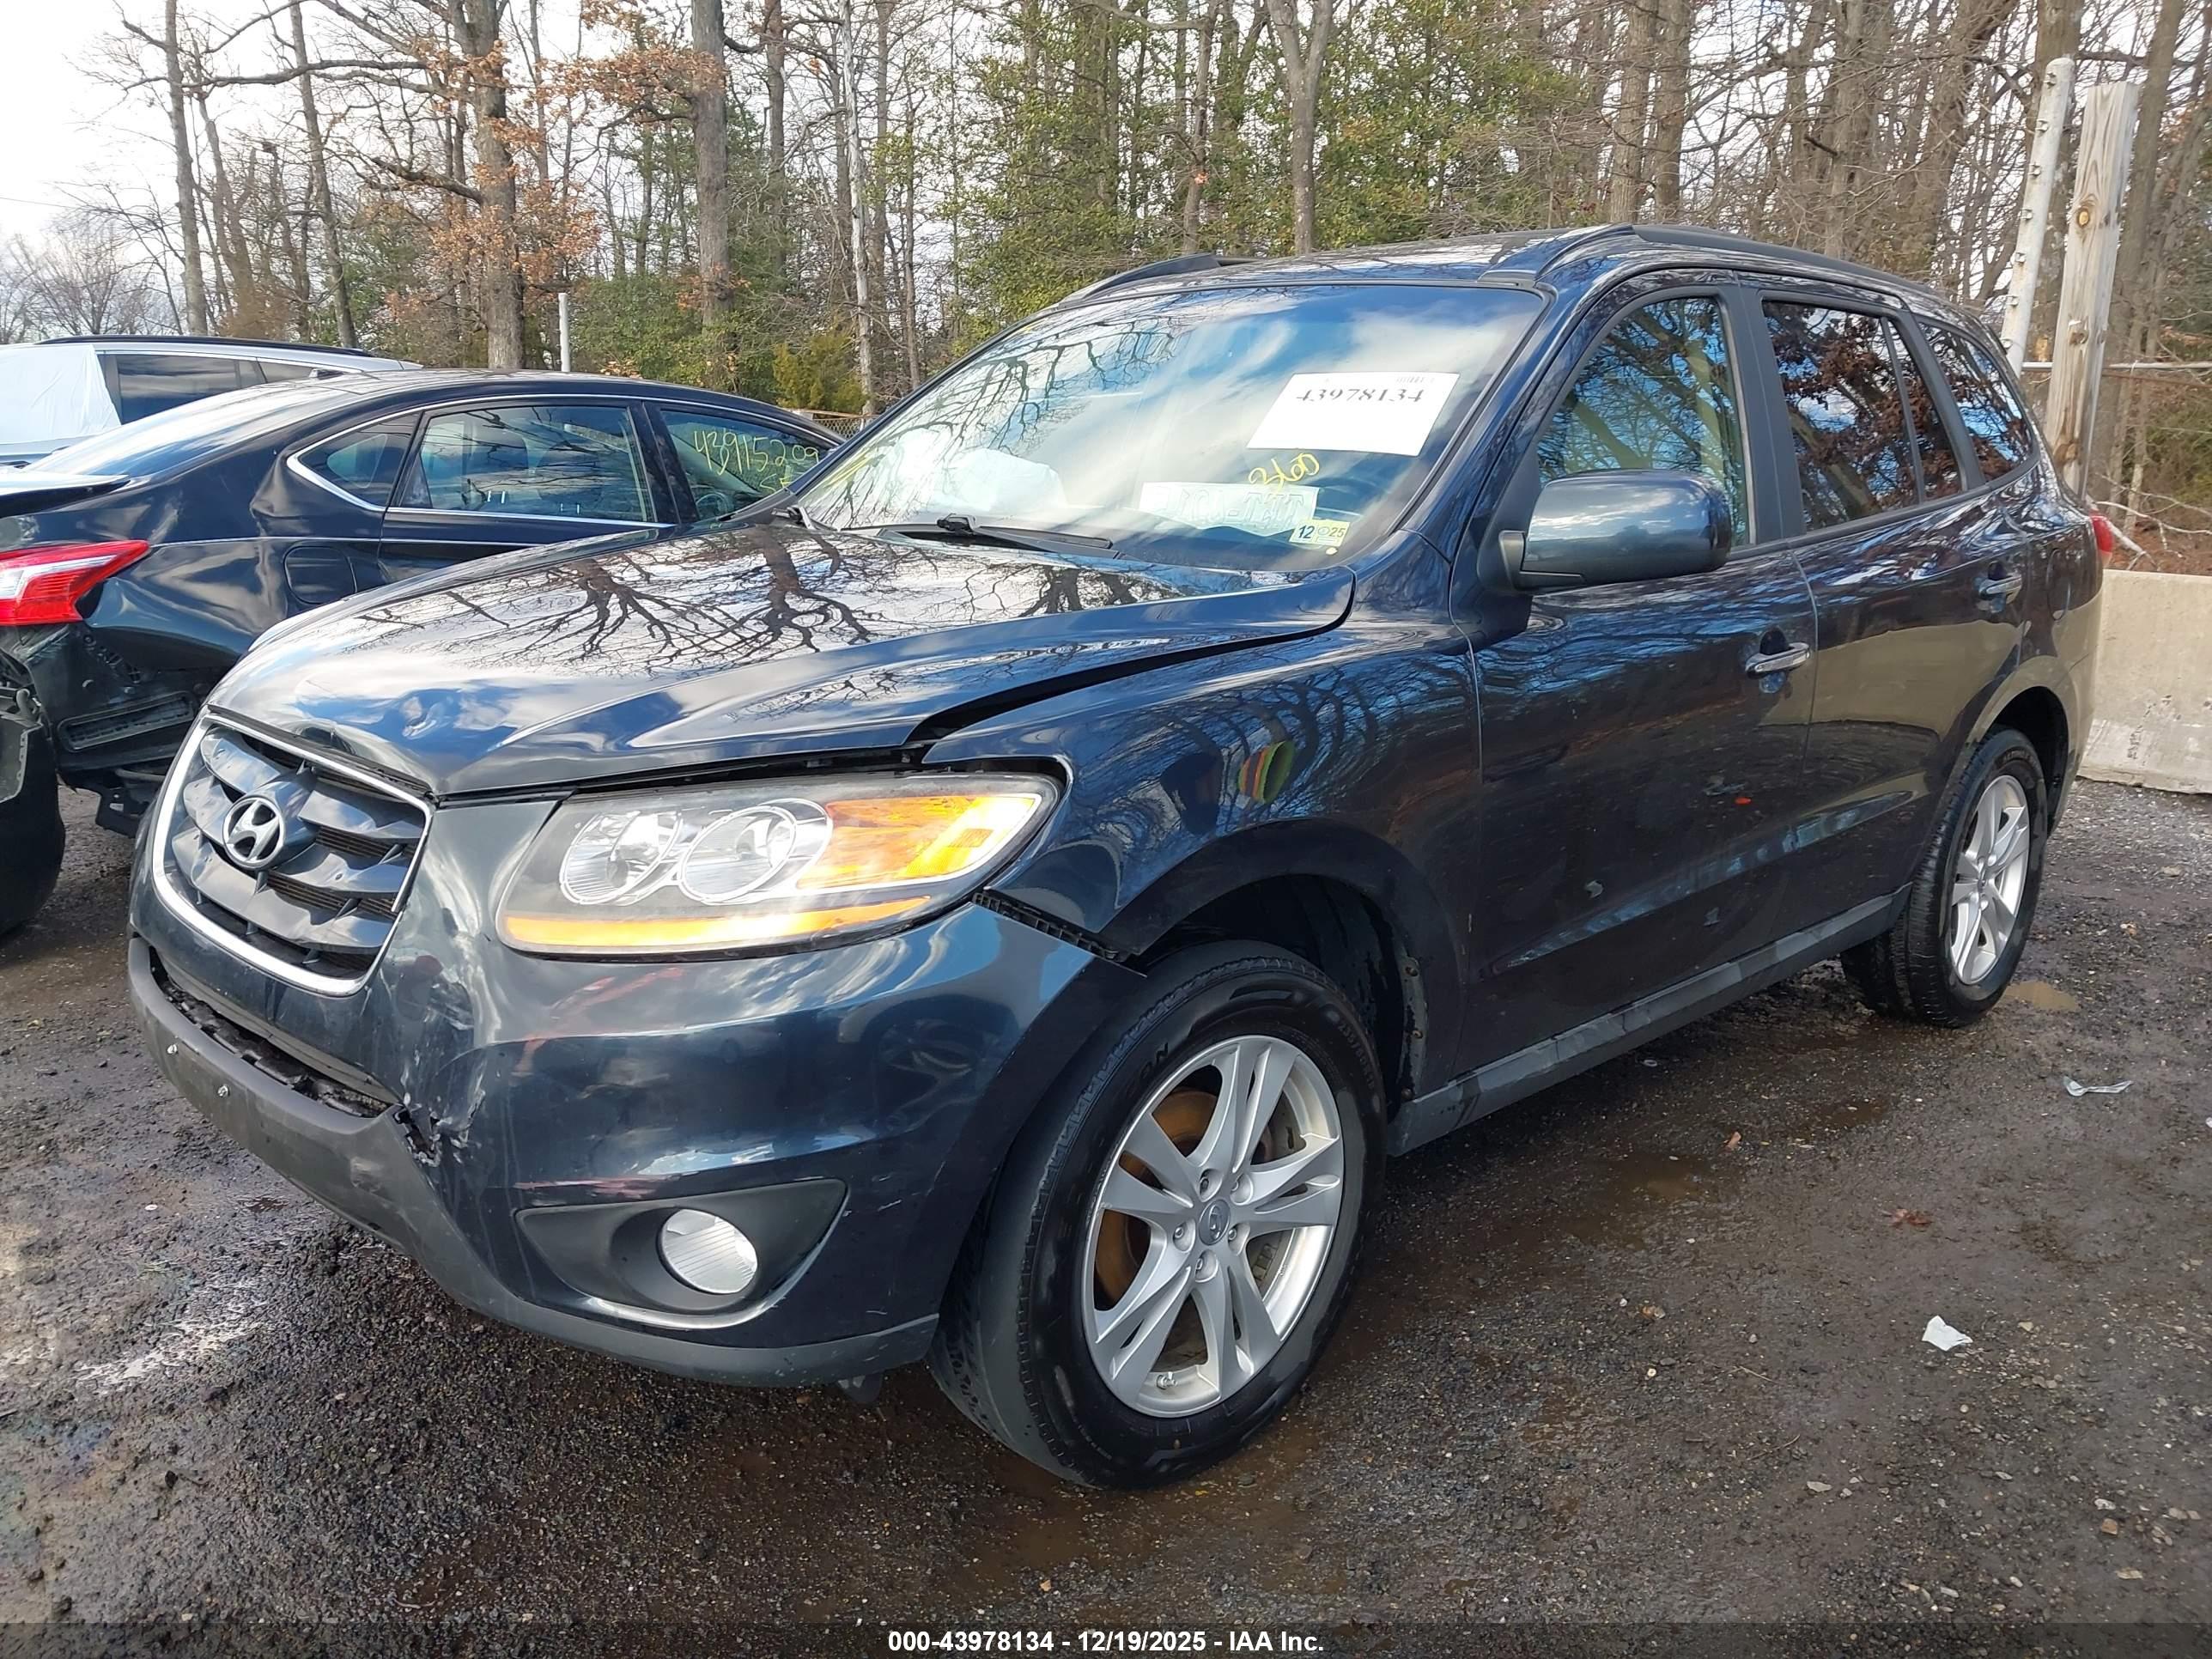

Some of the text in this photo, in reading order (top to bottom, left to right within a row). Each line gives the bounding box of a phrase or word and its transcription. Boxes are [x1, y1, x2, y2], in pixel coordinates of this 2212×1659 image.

[1295, 388, 1425, 403] 43978134
[1297, 525, 1346, 538] 12 25
